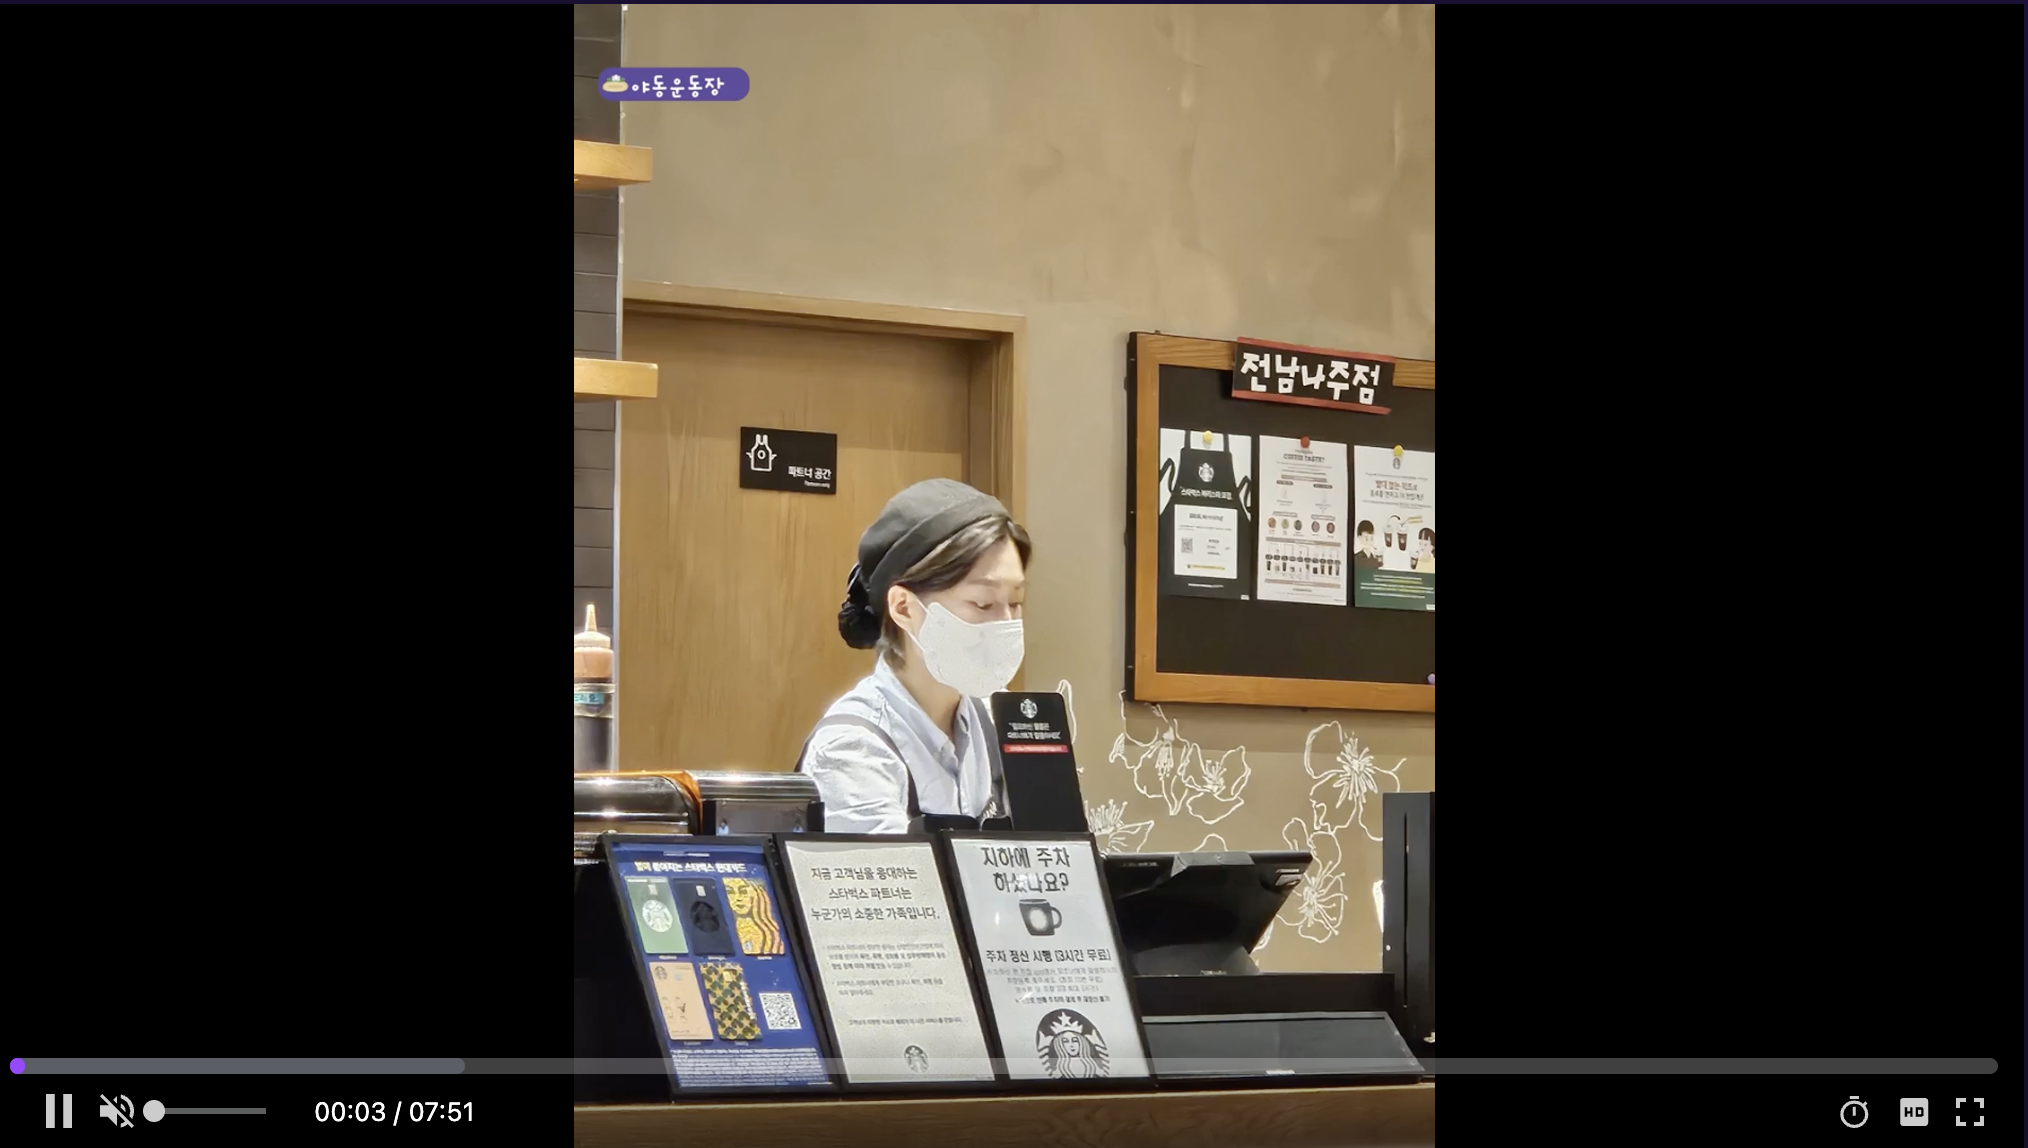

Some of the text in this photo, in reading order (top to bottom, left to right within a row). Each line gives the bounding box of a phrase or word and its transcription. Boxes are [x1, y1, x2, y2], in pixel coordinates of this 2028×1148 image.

[1240, 352, 1381, 405] 전남나주점
[788, 466, 832, 480] 파트너 공간
[980, 847, 1071, 868] 지하에 주차
[811, 867, 918, 880] 지금 고객님을 응대하는
[829, 887, 912, 900] 스타벅스 파트너는
[811, 906, 940, 921] 누군가의 소중한 가족입니다.
[986, 950, 1007, 962] 주차
[1009, 950, 1030, 963] 정산
